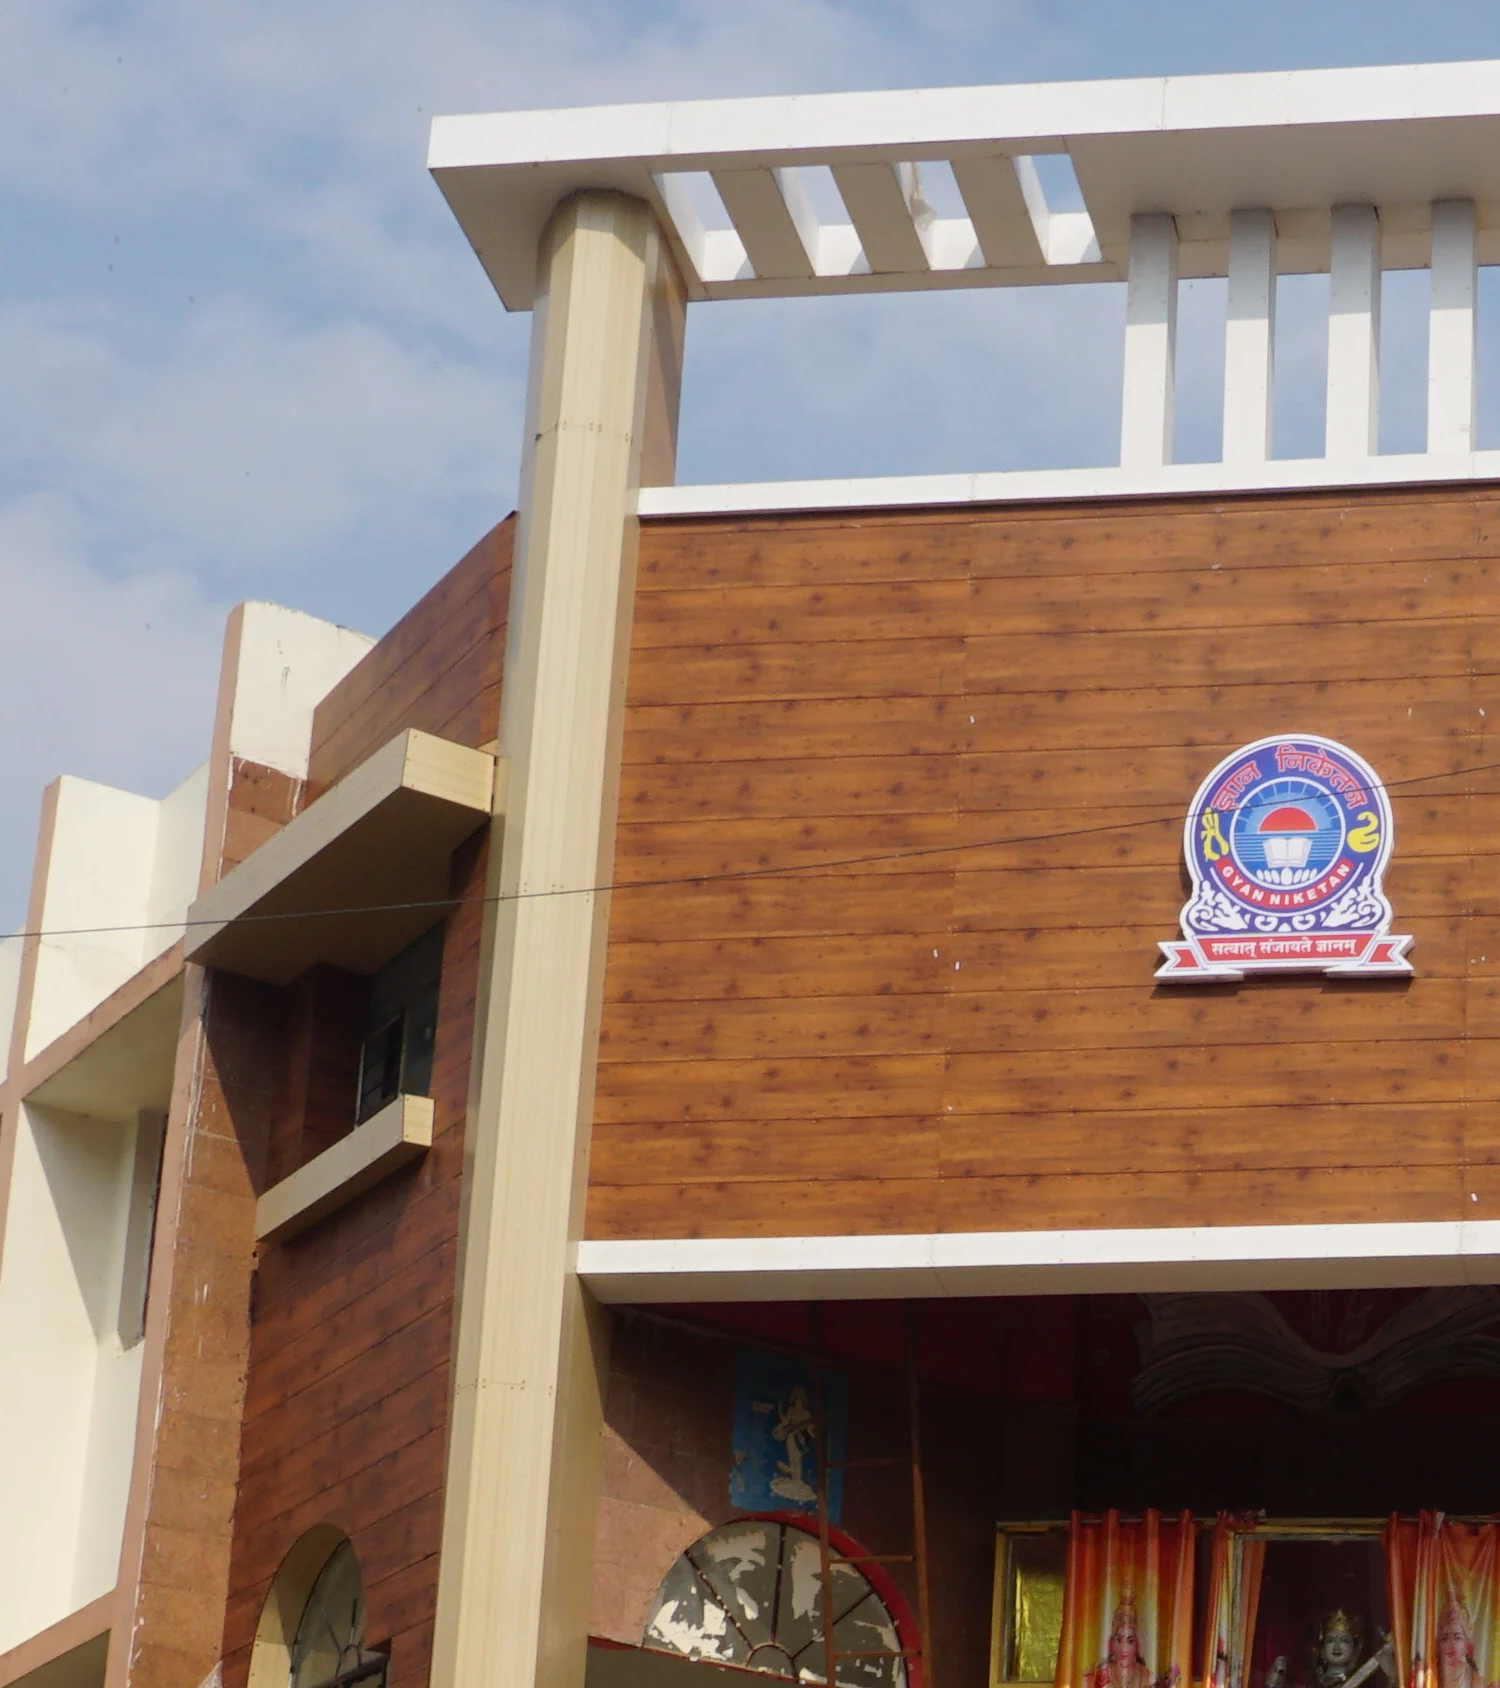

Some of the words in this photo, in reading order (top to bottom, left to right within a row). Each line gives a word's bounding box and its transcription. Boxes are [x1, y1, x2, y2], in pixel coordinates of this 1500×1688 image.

[1211, 760, 1262, 811] ज्ञान
[1275, 744, 1368, 810] निकेतन
[1221, 865, 1264, 902] GYAN
[1269, 863, 1351, 906] NIKETAN
